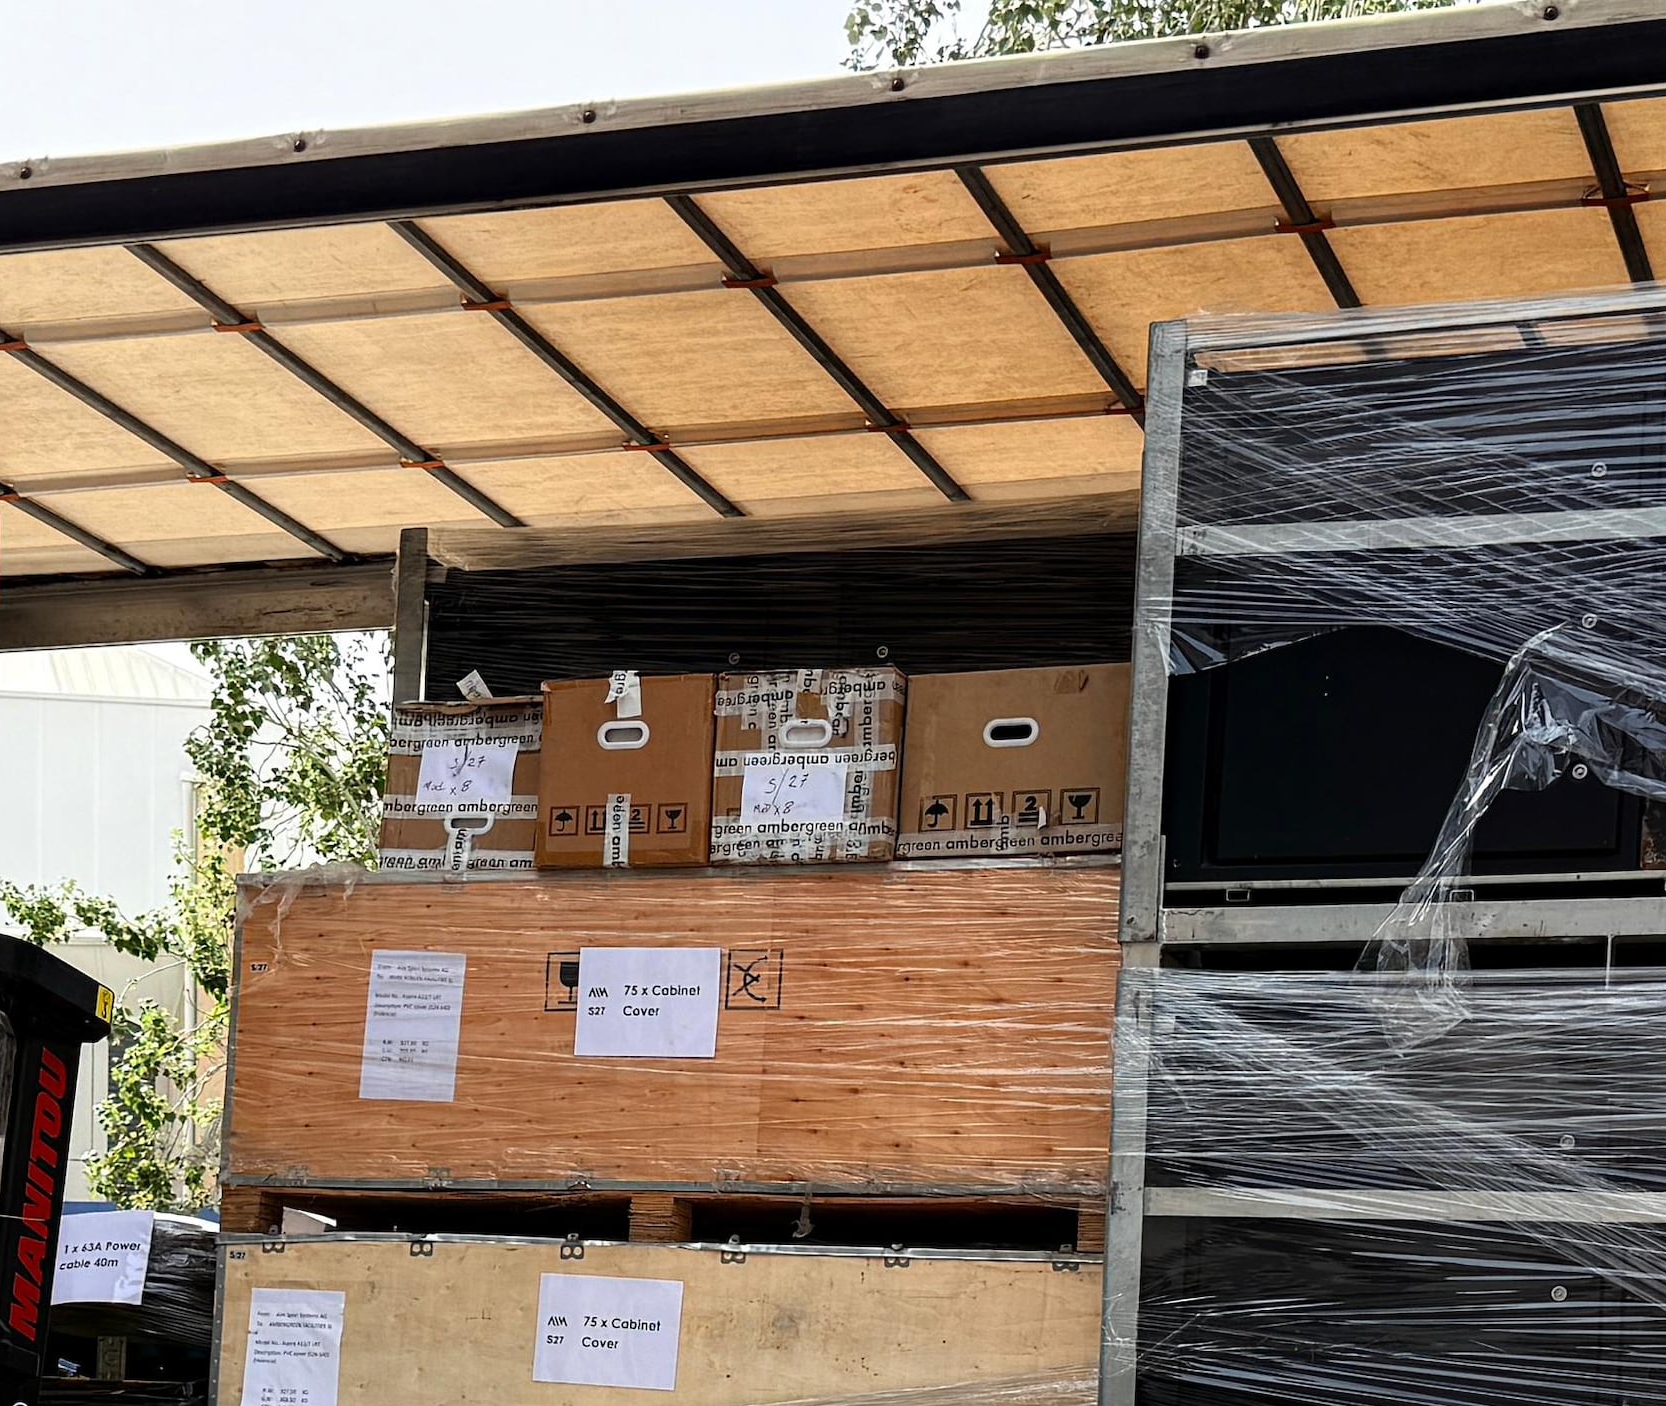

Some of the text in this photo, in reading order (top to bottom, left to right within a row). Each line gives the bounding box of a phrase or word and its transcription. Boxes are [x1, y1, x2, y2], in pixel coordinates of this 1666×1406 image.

[743, 753, 829, 770] ambergreen
[458, 798, 538, 816] ambergreen
[757, 818, 844, 836] ambergreen
[624, 985, 638, 996] 75
[652, 985, 701, 997] Cabinet
[588, 1006, 660, 1017] S27 Cover
[8, 1050, 70, 1342] MANITOU
[81, 1242, 102, 1252] 63A
[106, 1242, 142, 1251] Power
[59, 1258, 119, 1270] cable 40m
[583, 1315, 598, 1327] 75
[601, 1319, 608, 1328] x
[611, 1317, 661, 1332] Cabinet
[546, 1335, 620, 1349] S27 Cover
